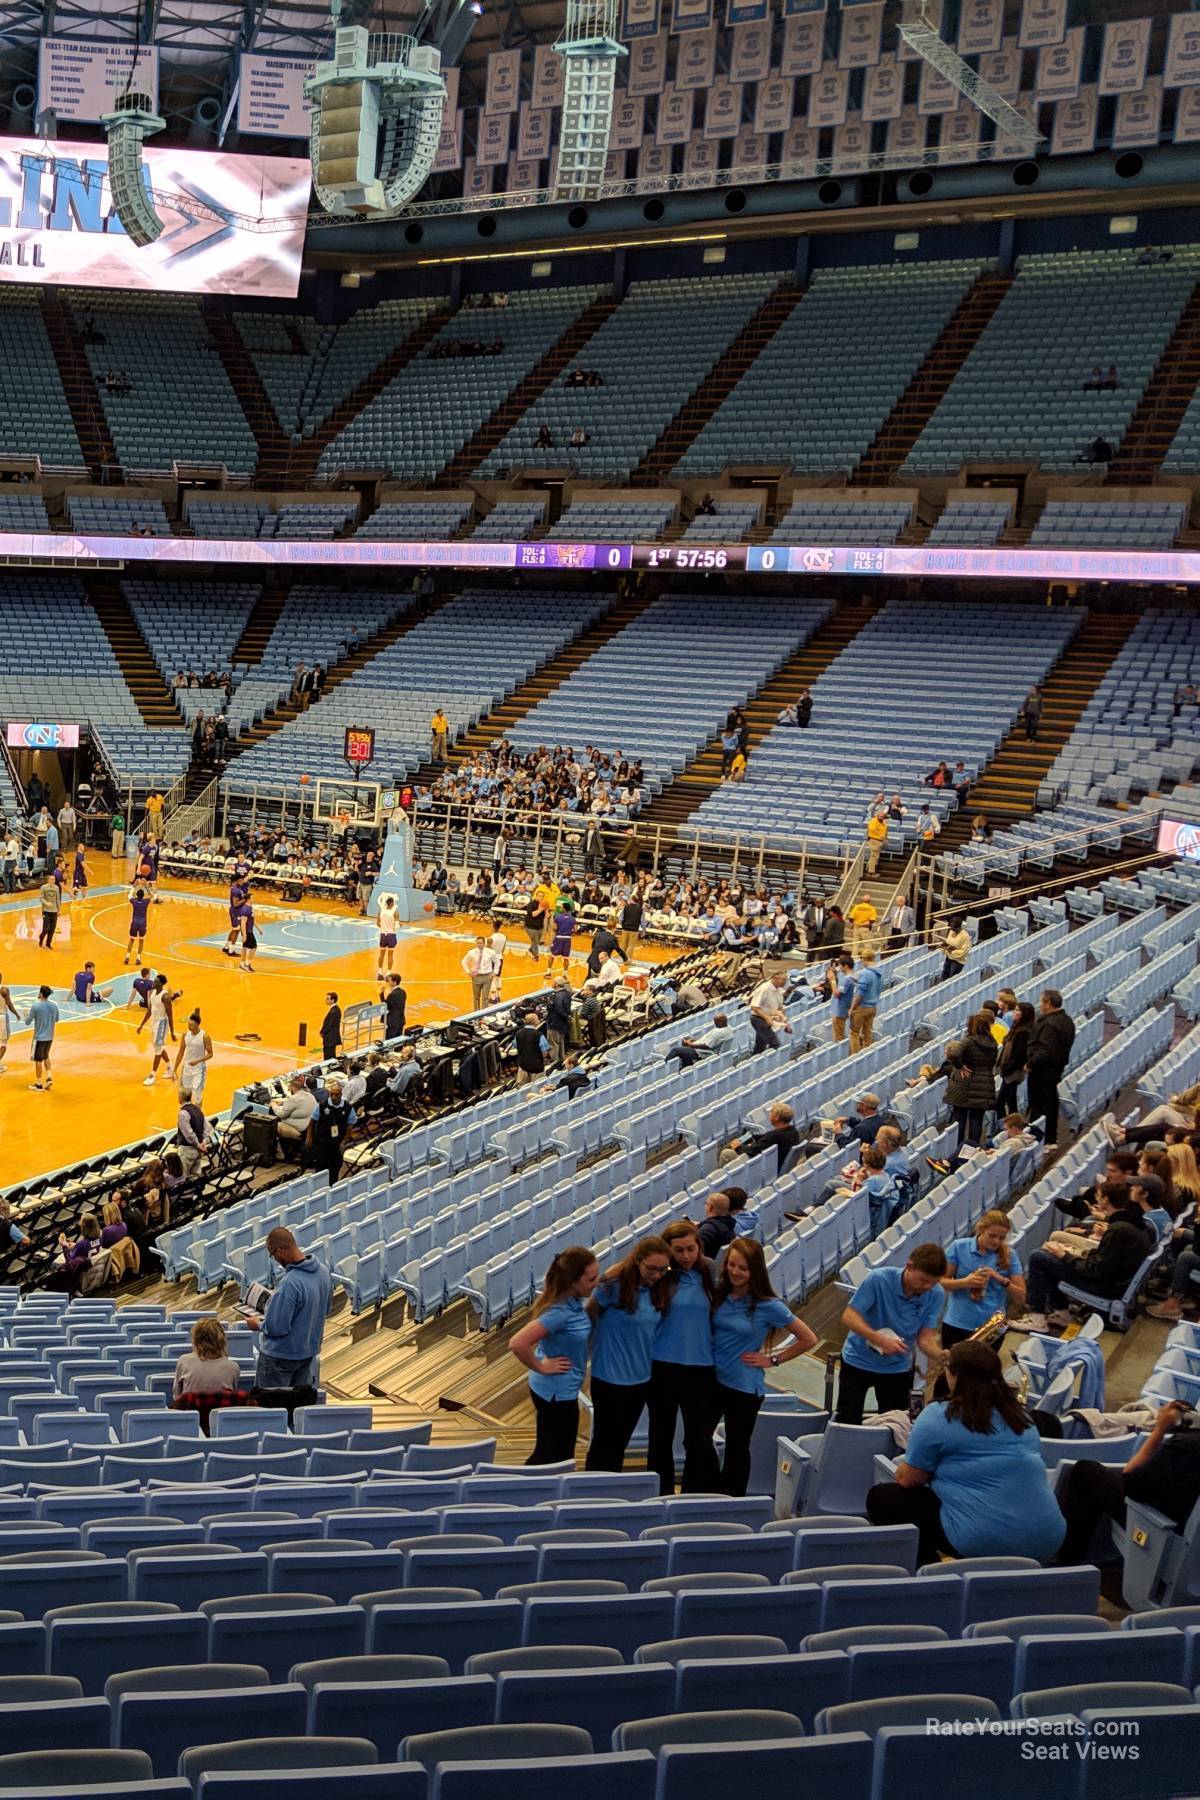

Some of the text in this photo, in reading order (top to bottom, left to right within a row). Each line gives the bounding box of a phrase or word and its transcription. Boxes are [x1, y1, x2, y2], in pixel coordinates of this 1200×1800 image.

[608, 548, 621, 566] 0
[649, 549, 727, 567] 1ST 57:56
[762, 550, 775, 569] 0
[854, 560, 882, 569] FLS: 0
[876, 552, 883, 561] 4
[924, 554, 966, 570] HOME
[996, 556, 1073, 572] CAROLINA
[1078, 557, 1181, 575] BASKETBALL
[351, 742, 368, 757] 30
